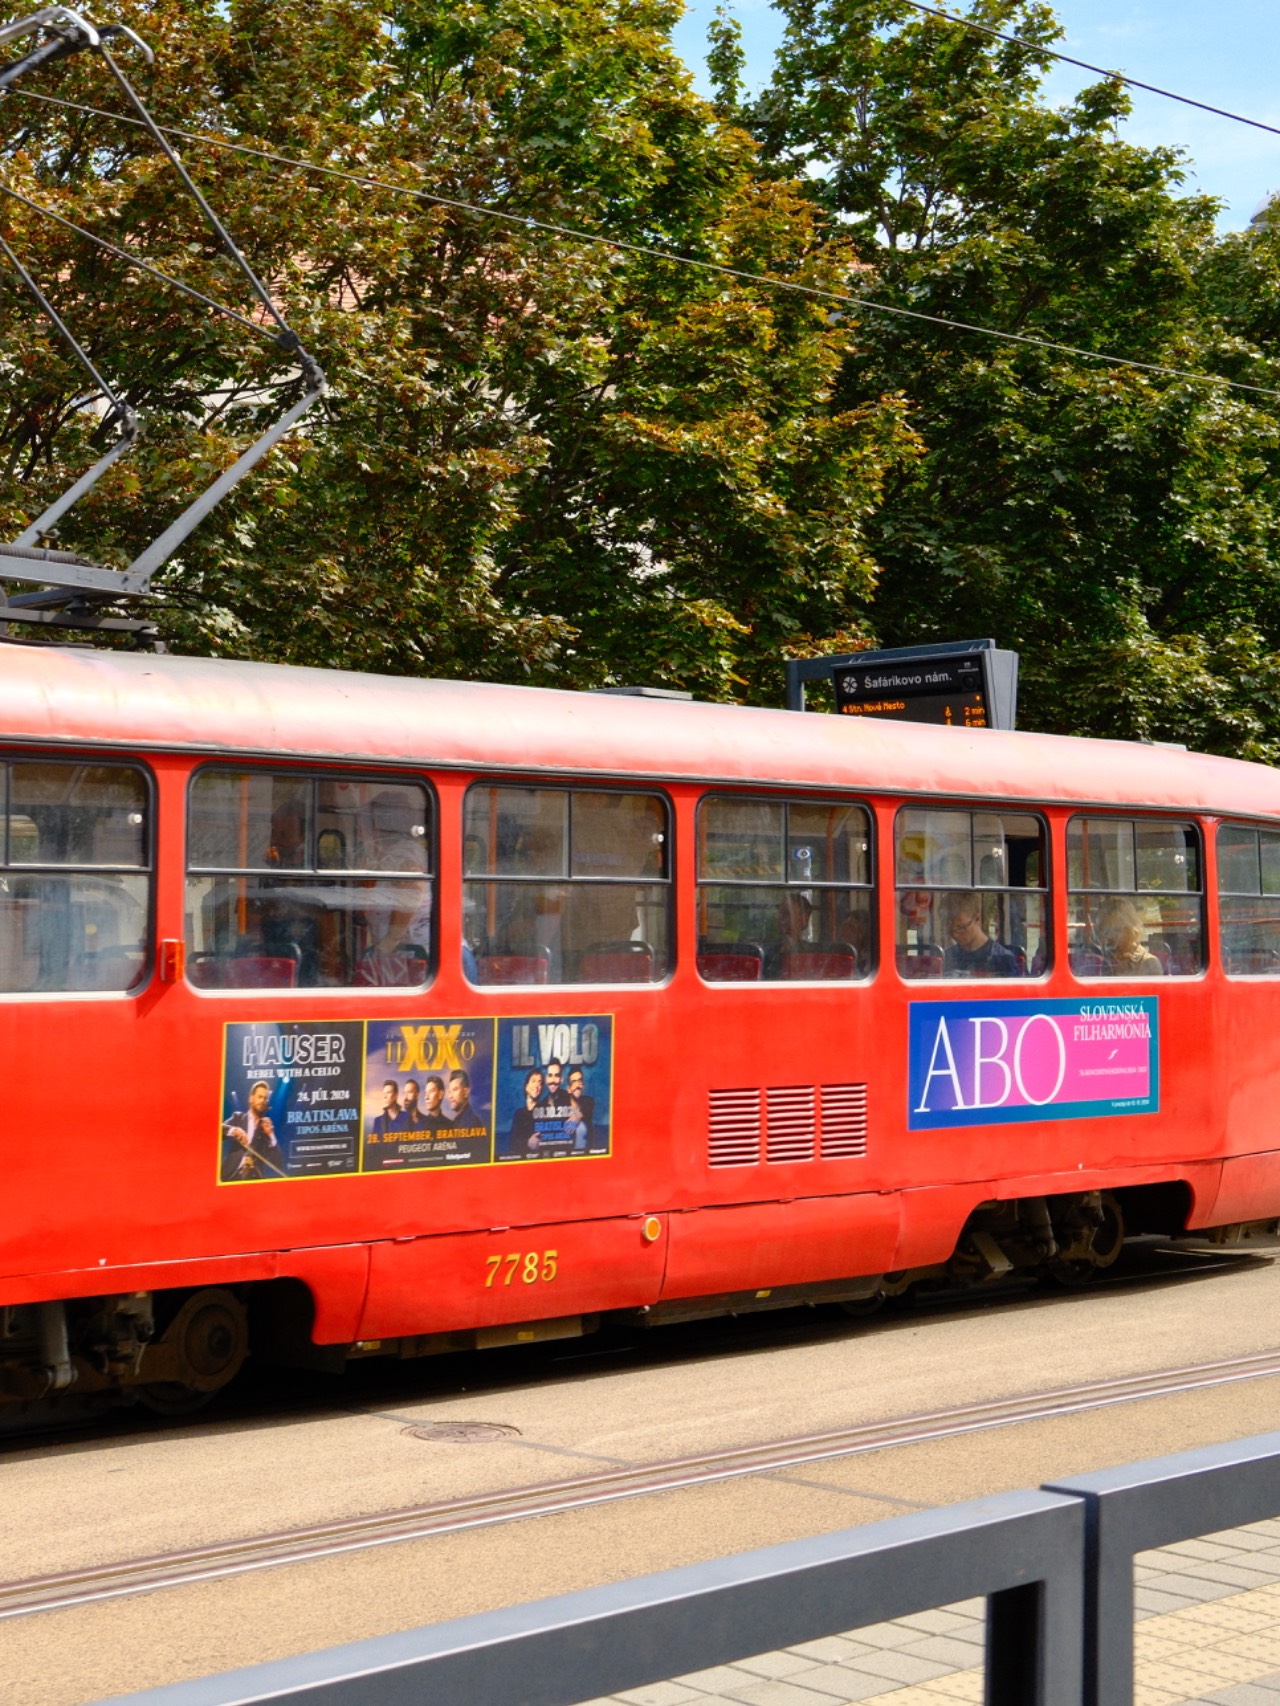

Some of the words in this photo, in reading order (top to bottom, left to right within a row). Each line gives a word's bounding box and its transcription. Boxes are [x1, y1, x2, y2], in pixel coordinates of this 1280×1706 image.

[864, 675, 922, 689] Šafárikovo
[925, 671, 952, 684] nám.
[842, 705, 848, 714] 4
[863, 702, 882, 712] Nové
[883, 701, 905, 711] Mesto
[964, 706, 970, 716] 2
[971, 706, 985, 715] min
[972, 718, 986, 727] min
[1079, 1001, 1146, 1022] SLOVENSKÁ
[1074, 1020, 1152, 1042] FILHARMÓNIA
[242, 1034, 345, 1066] HAUSER
[398, 1024, 463, 1072] XX
[512, 1025, 534, 1066] IL
[538, 1023, 599, 1065] VOLO
[914, 1014, 1066, 1112] ABO
[247, 1069, 275, 1079] REBEL
[277, 1068, 302, 1078] WITH
[302, 1068, 311, 1077] A
[312, 1066, 341, 1076] CELLO
[287, 1108, 359, 1124] BRATISLAVA
[296, 1125, 320, 1135] TIPOS
[383, 1129, 433, 1142] SEPTEMBER,
[436, 1127, 487, 1139] BRATISLAVA
[398, 1143, 431, 1153] PEUGEOT
[484, 1249, 559, 1288] 7785
